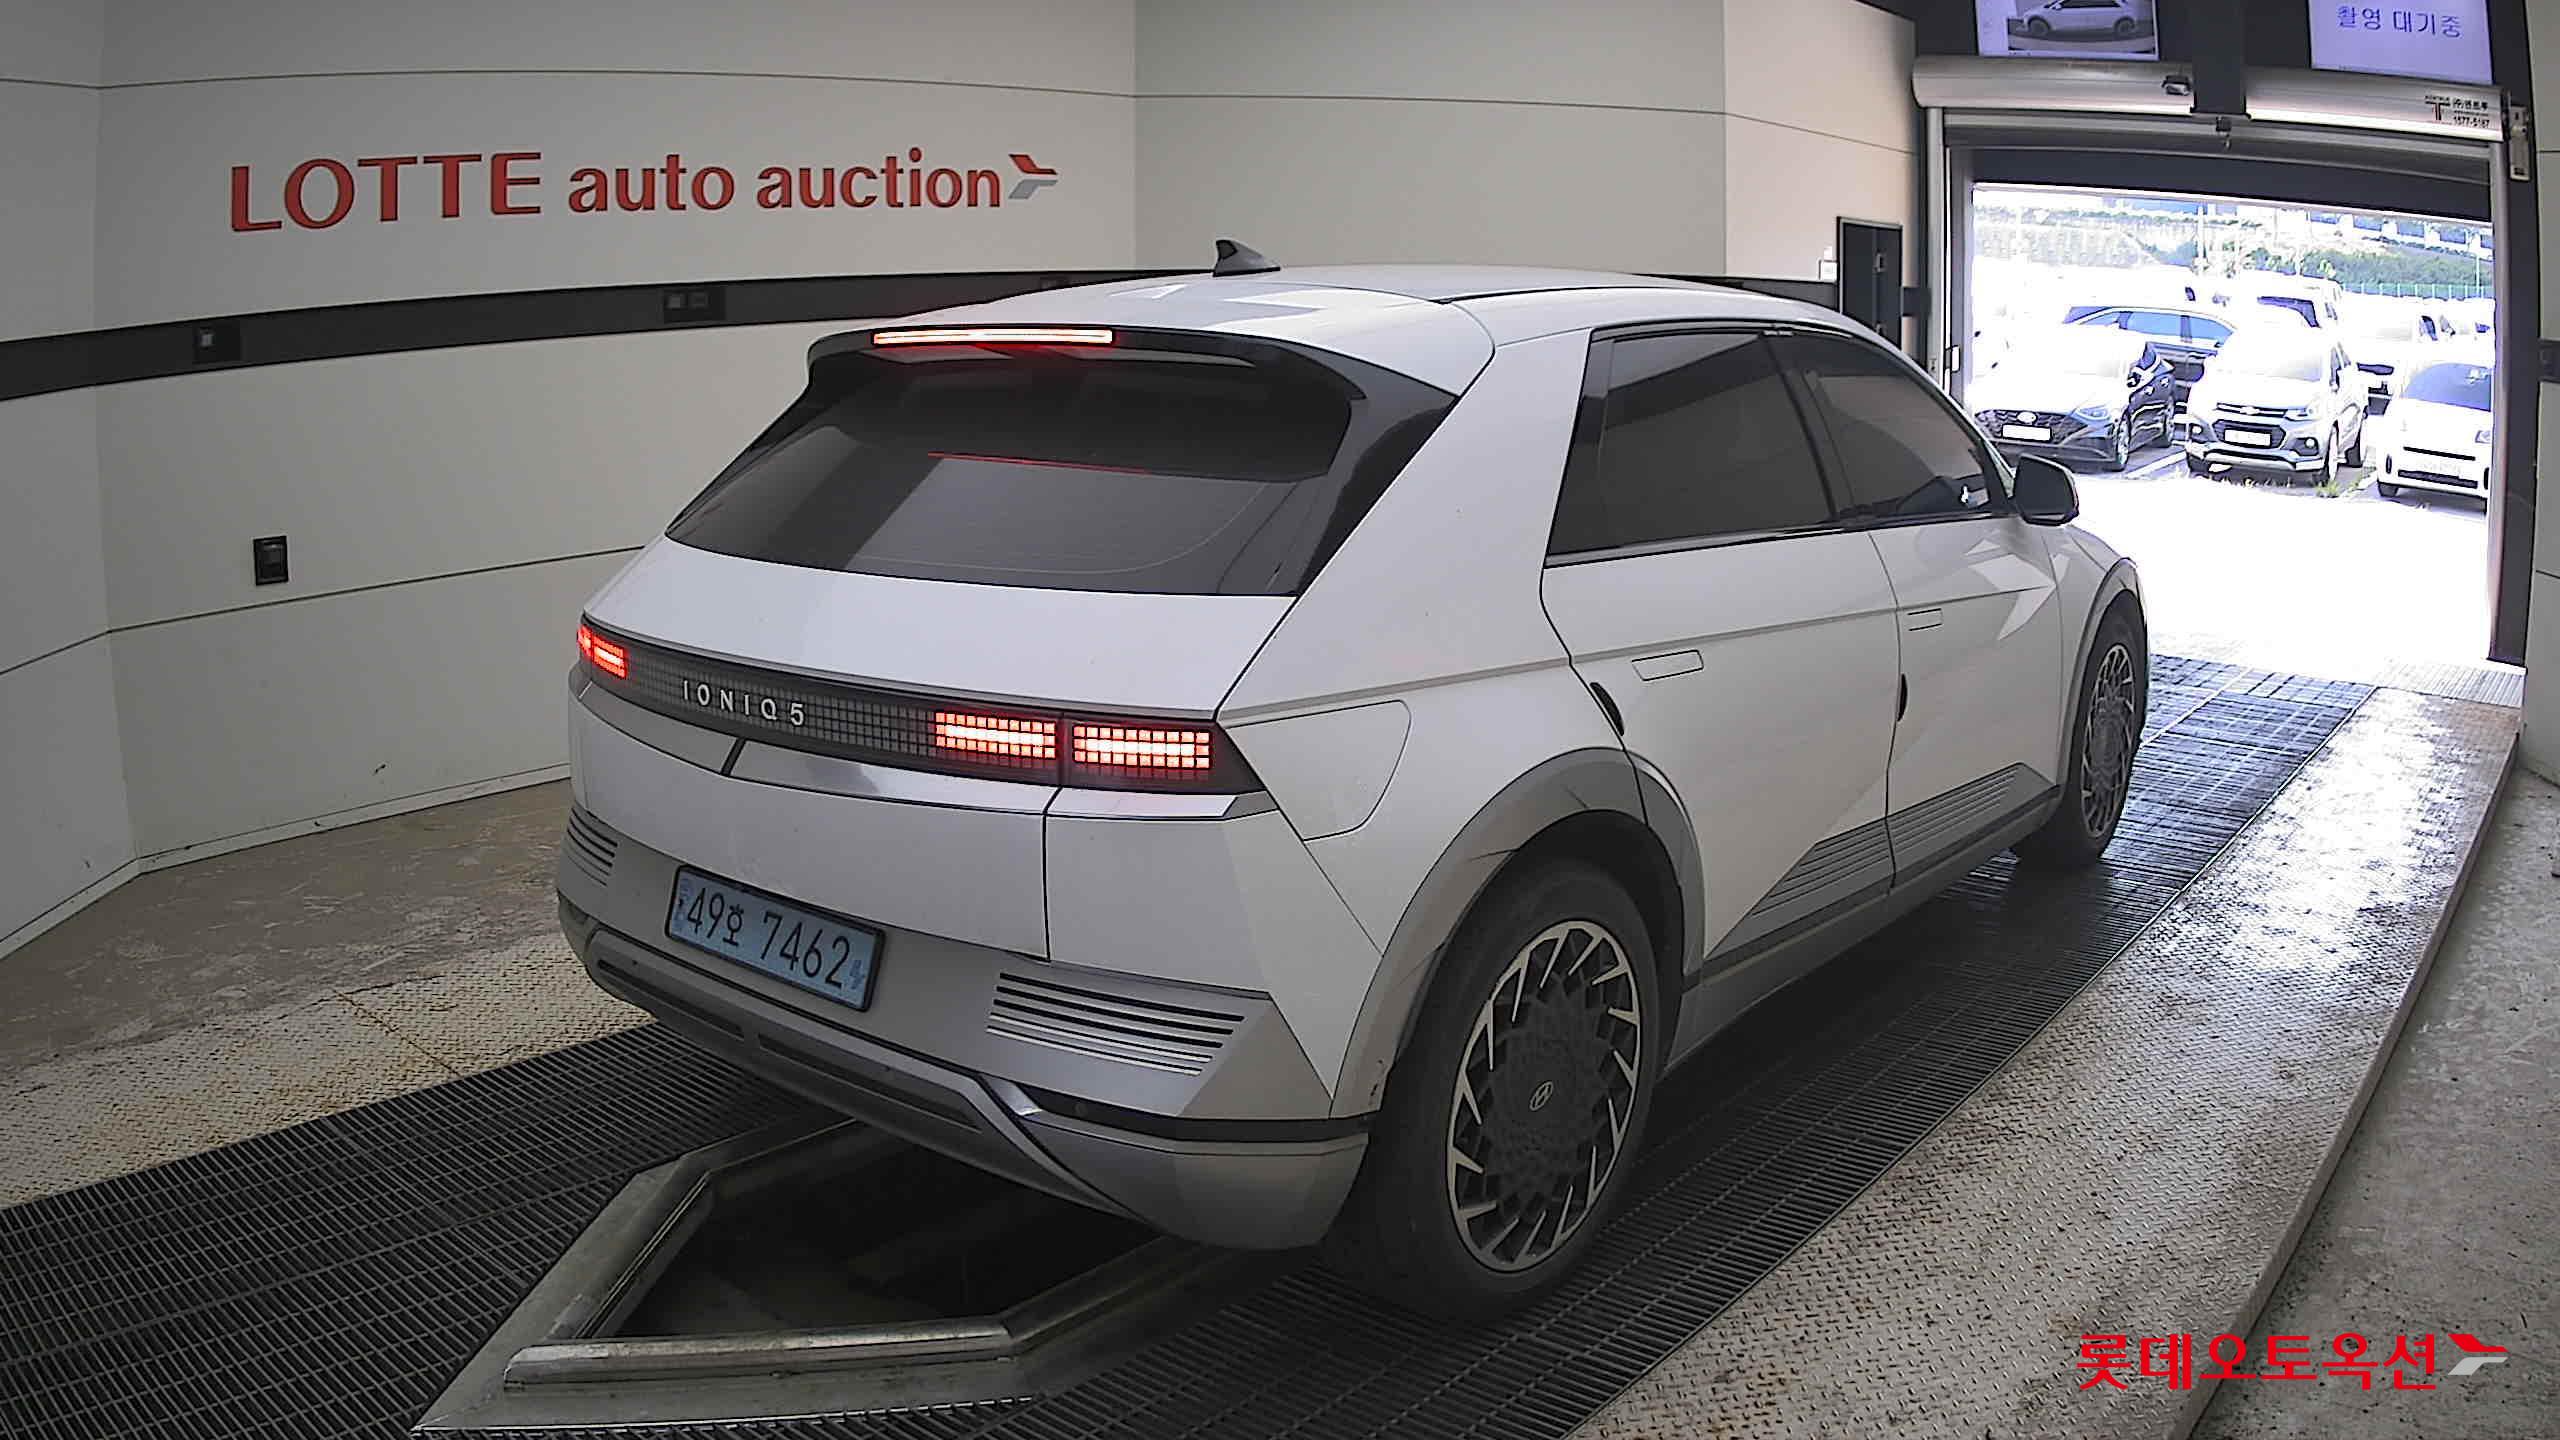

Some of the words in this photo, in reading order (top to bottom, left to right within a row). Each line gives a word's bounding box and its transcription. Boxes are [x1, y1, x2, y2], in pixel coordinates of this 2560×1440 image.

[2337, 5, 2383, 31] 촬영
[2392, 11, 2463, 39] 대기중
[230, 151, 542, 232] LOTTE
[569, 153, 735, 213] auto
[756, 146, 1001, 209] auction
[683, 679, 777, 721] IONIQ
[789, 701, 805, 727] 5
[686, 886, 745, 947] 49호
[760, 910, 851, 989] 7462
